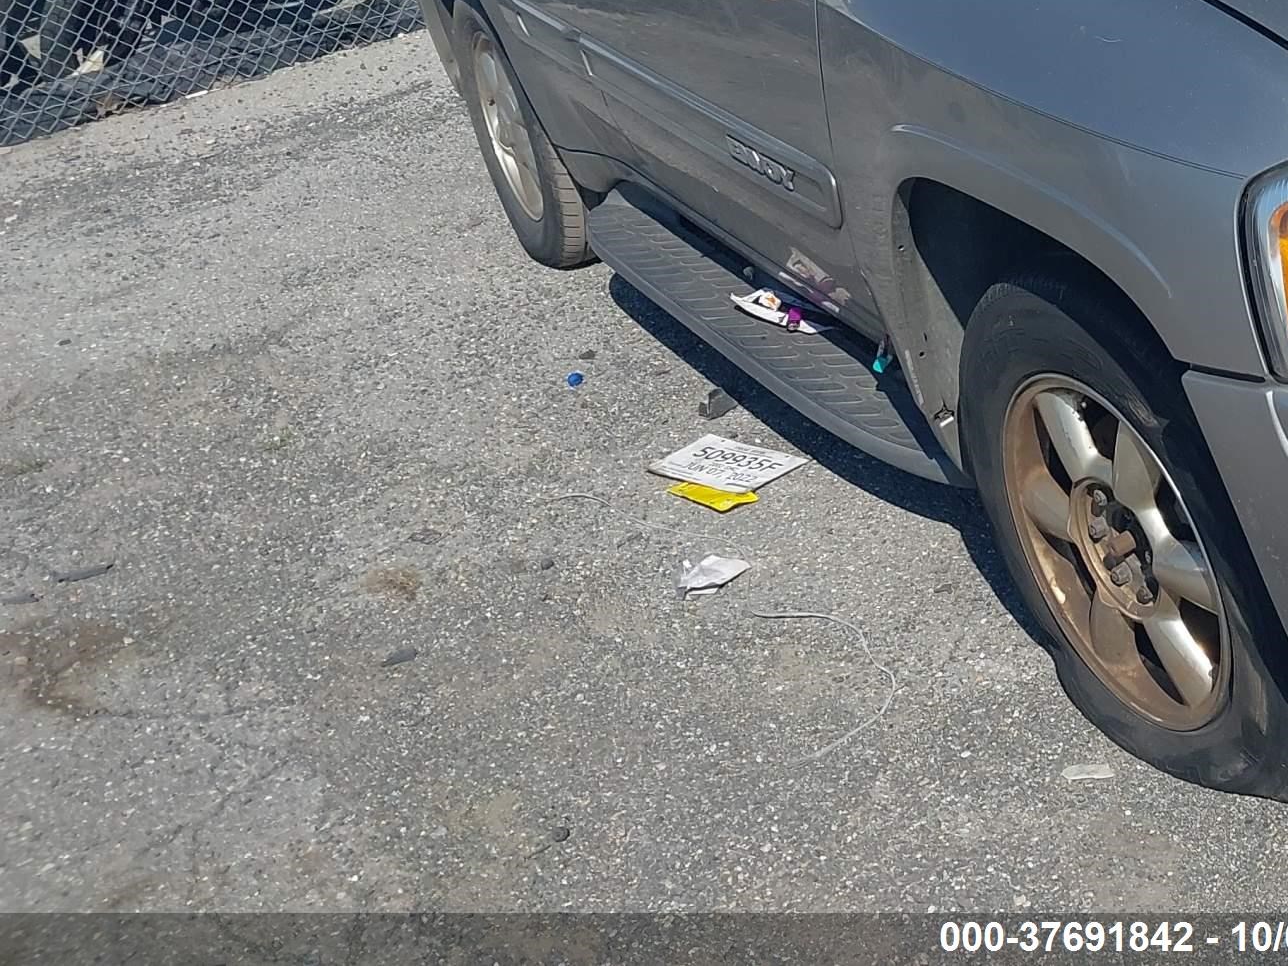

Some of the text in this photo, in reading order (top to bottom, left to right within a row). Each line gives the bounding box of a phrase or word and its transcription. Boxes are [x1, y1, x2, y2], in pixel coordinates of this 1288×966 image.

[692, 445, 784, 473] 509935F
[684, 461, 708, 473] JUN
[727, 471, 759, 483] 2022
